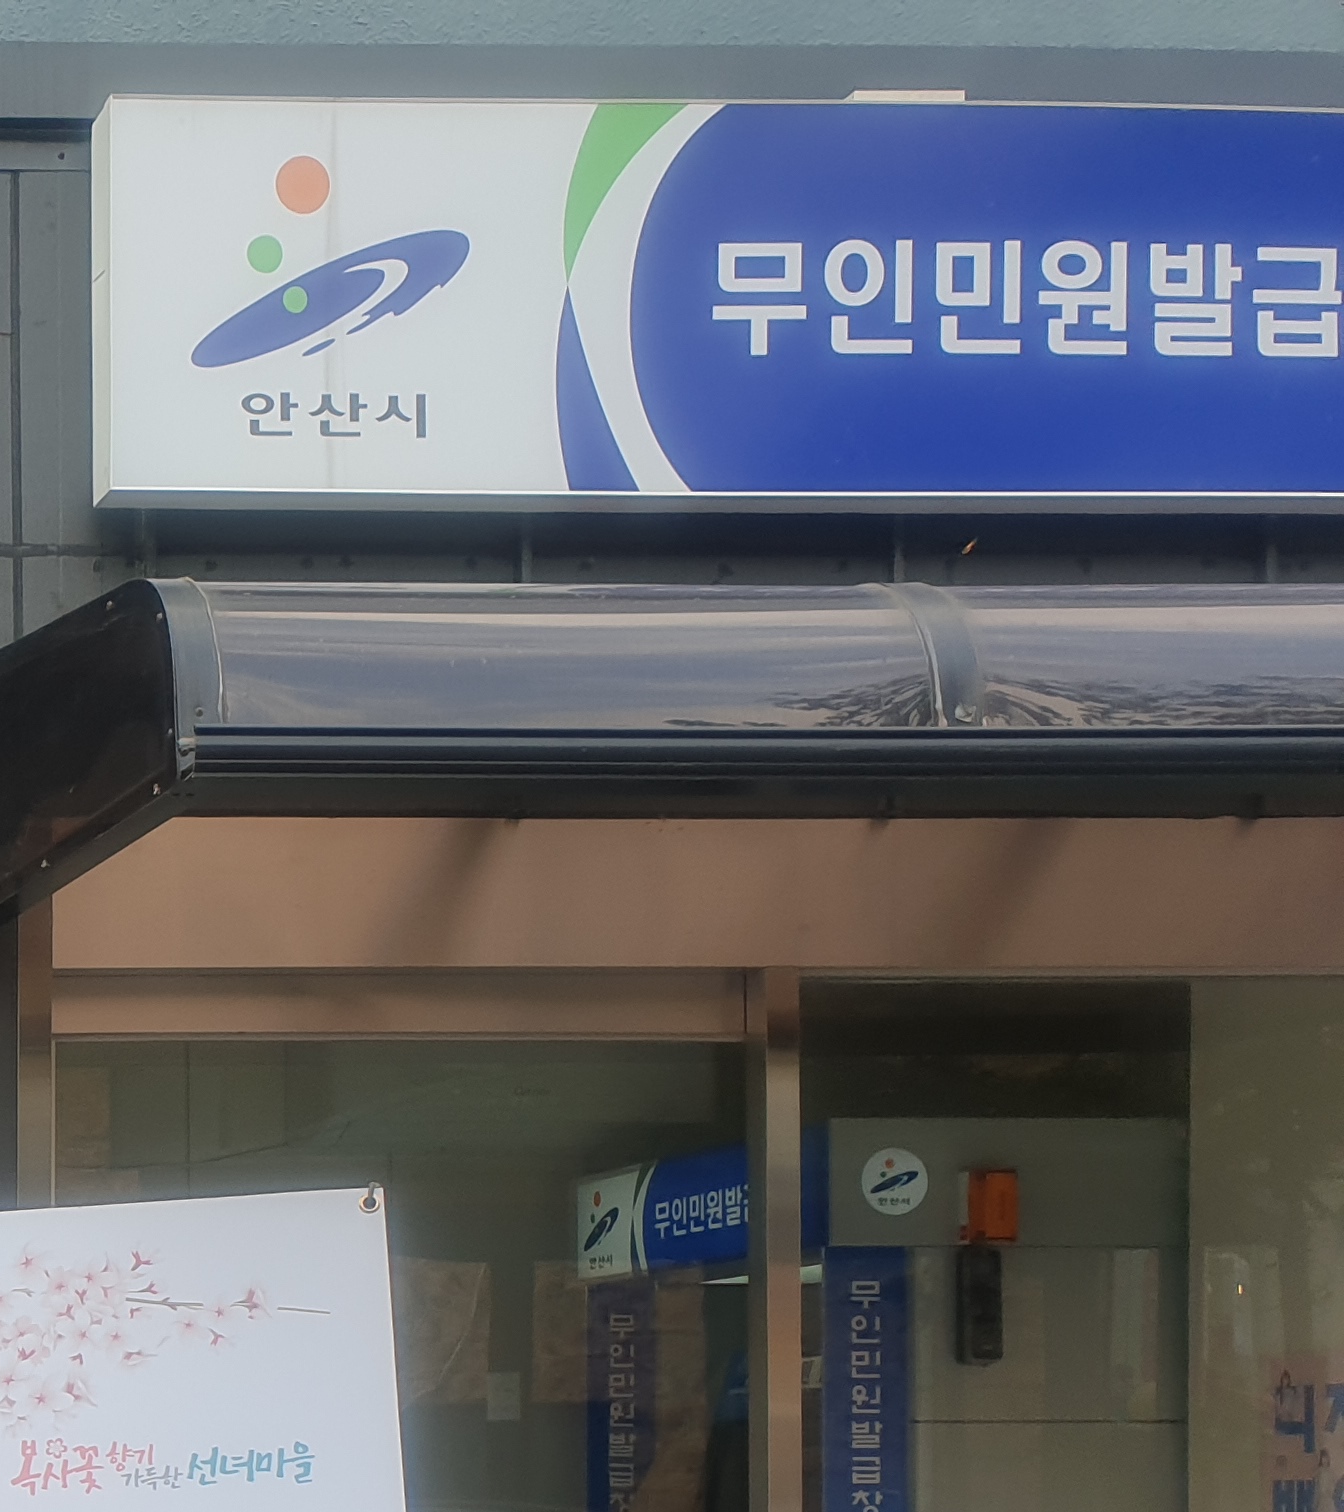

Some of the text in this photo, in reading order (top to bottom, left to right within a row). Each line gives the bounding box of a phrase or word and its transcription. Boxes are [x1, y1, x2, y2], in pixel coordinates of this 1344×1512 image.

[240, 390, 431, 441] 안산시
[588, 1253, 613, 1271] 안산시
[10, 1439, 315, 1496] 복사꽃 향기 가득한 선녀마을
